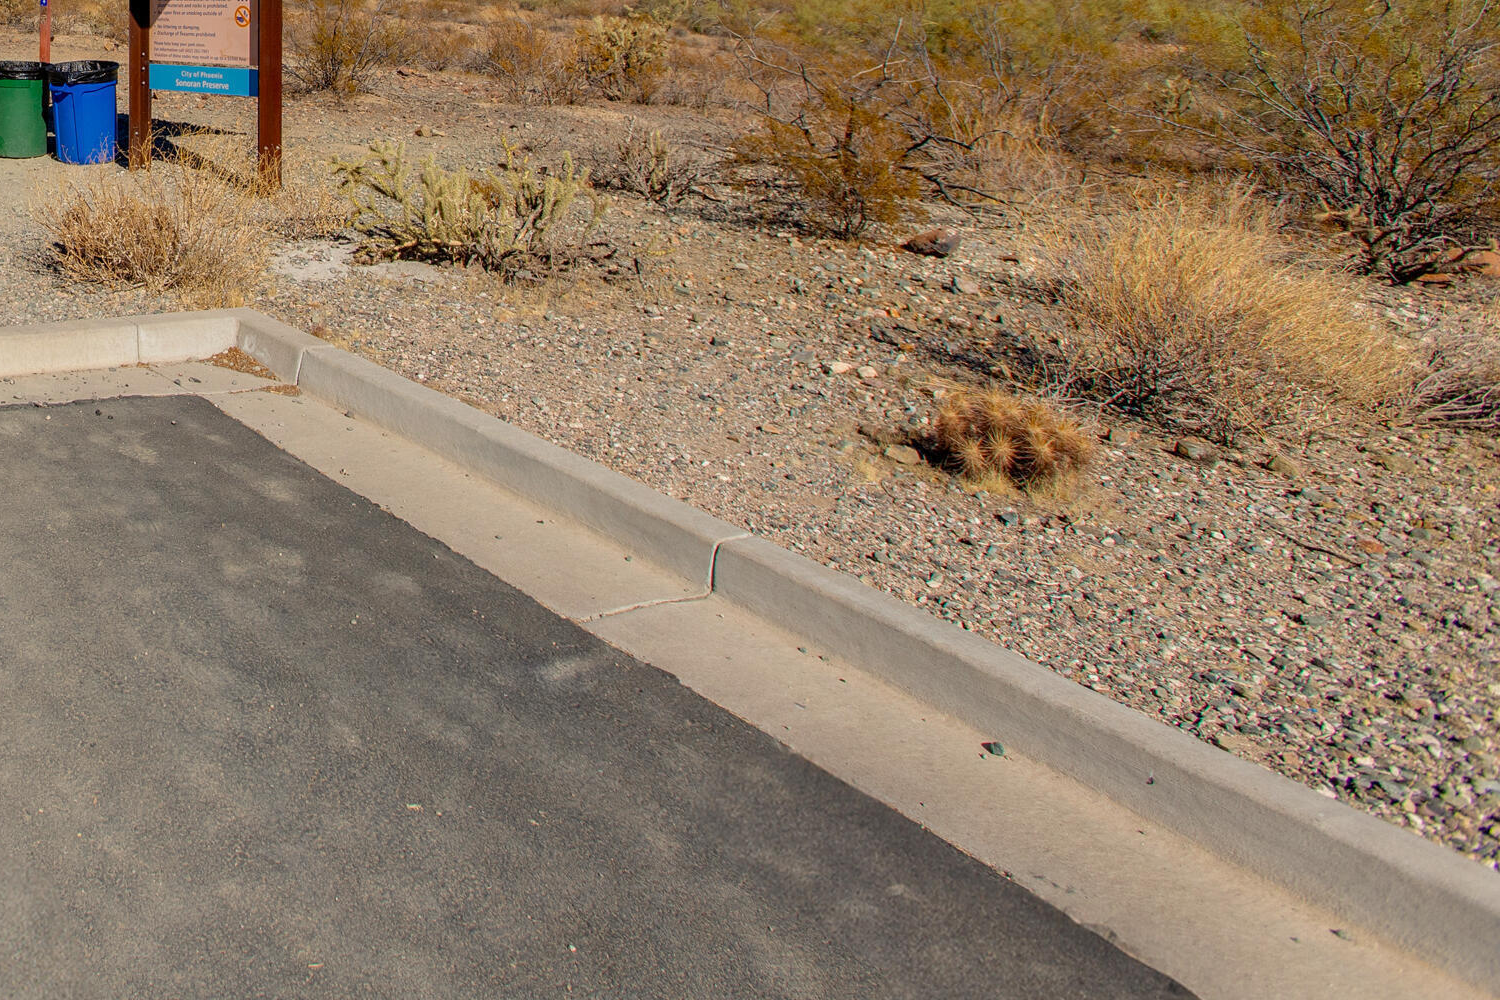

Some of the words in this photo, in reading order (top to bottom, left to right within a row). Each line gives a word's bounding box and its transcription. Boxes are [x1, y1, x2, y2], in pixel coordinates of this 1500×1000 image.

[181, 70, 192, 78] City
[176, 79, 201, 87] Sonoran
[202, 80, 230, 90] Preserve
